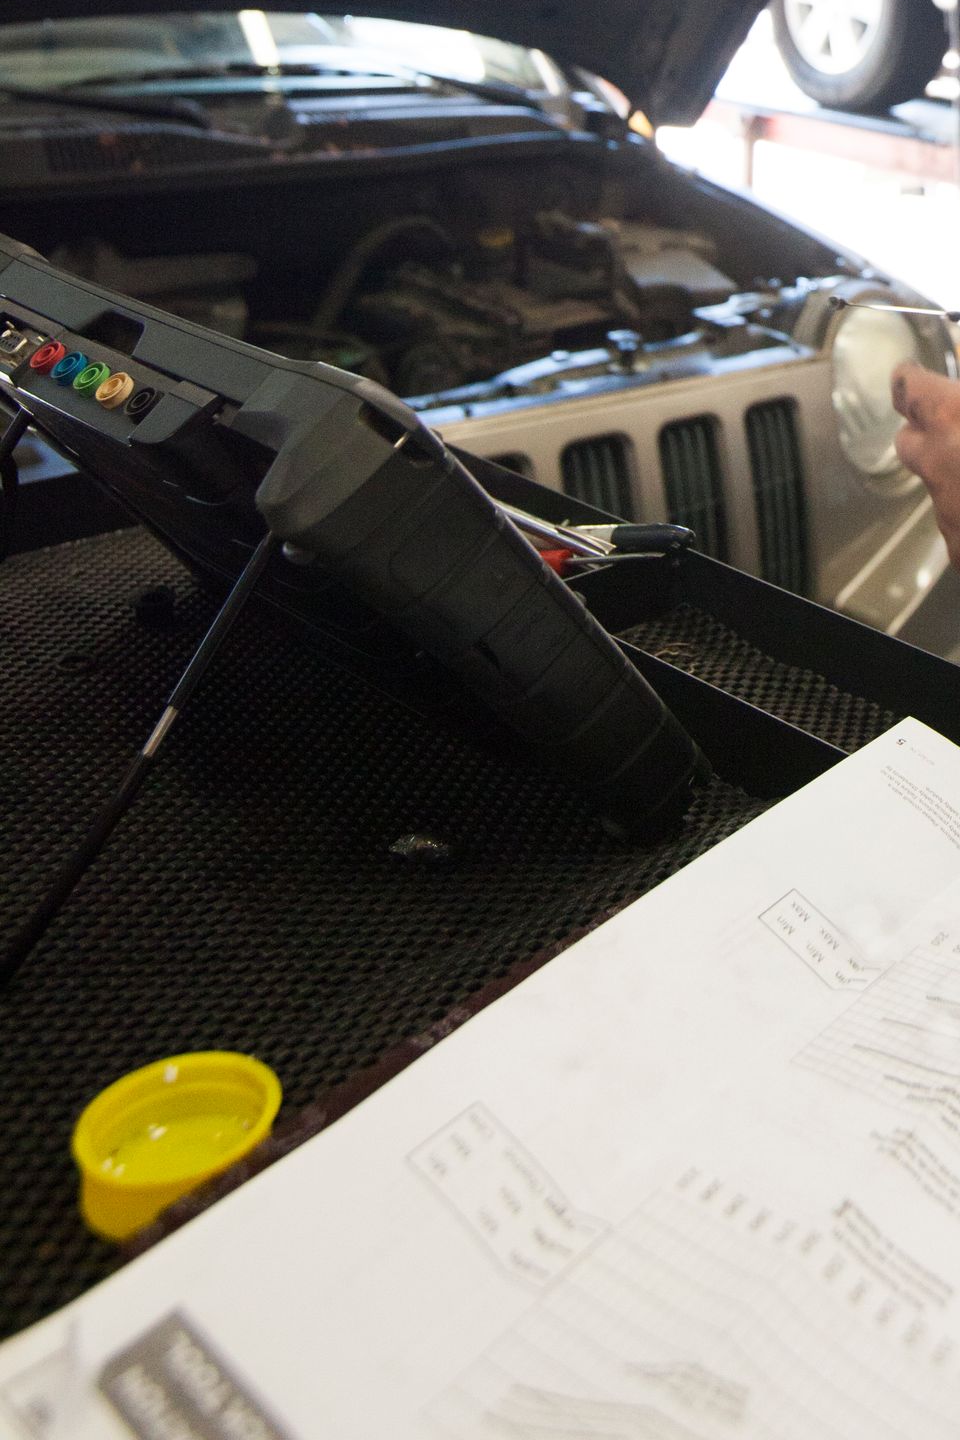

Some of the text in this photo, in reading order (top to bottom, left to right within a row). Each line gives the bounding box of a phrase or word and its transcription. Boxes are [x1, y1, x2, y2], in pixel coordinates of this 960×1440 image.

[896, 737, 906, 746] 5
[792, 902, 810, 922] Max
[777, 916, 794, 935] Min
[821, 928, 839, 950] Max
[806, 944, 824, 963] Min
